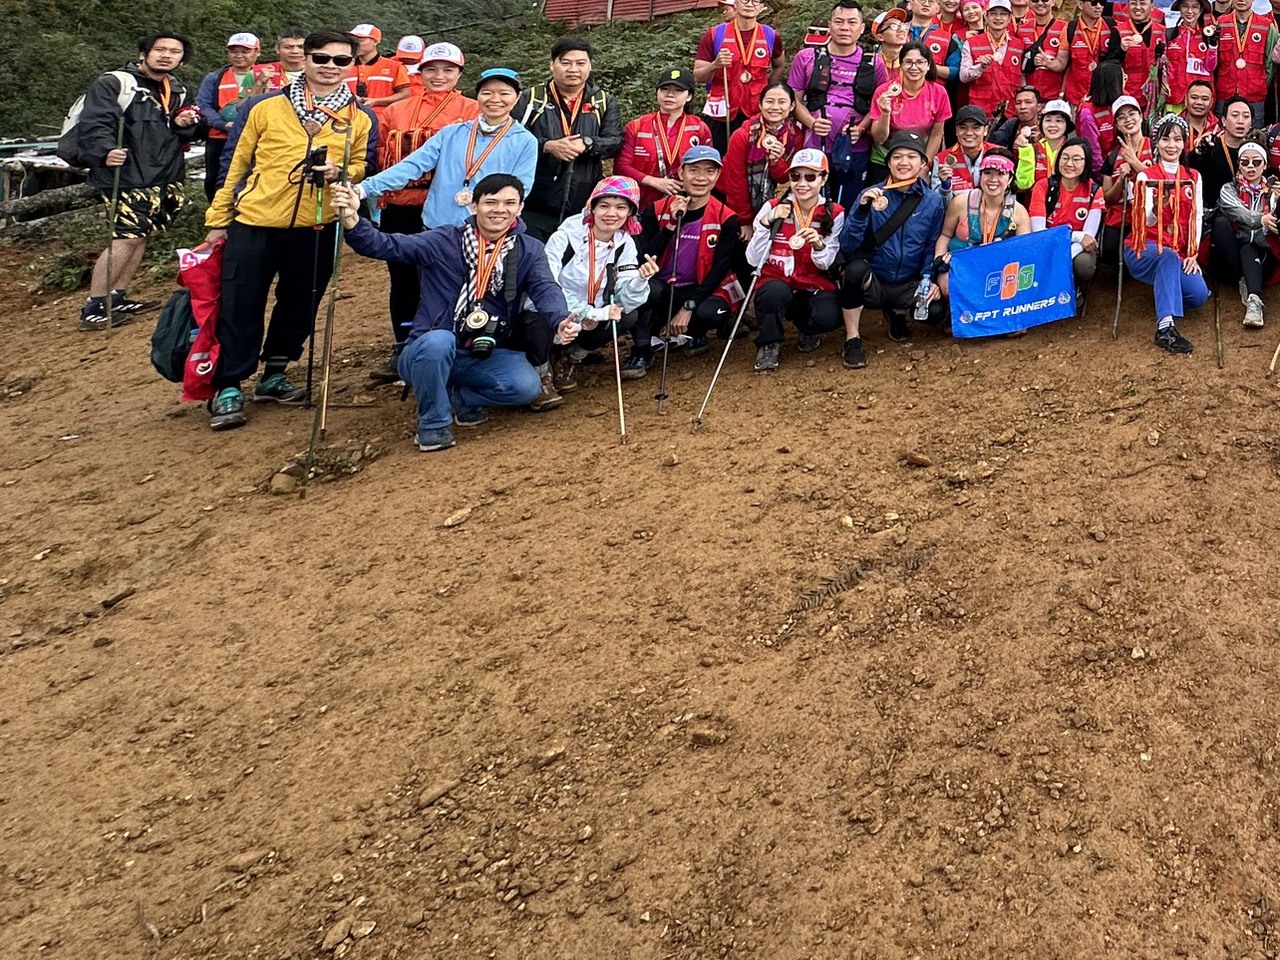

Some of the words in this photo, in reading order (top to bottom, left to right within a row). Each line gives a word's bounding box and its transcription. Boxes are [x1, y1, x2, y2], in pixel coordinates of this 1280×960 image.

[986, 267, 1034, 293] FPT
[974, 309, 1000, 321] FPT
[1002, 296, 1056, 317] RUNNERS
